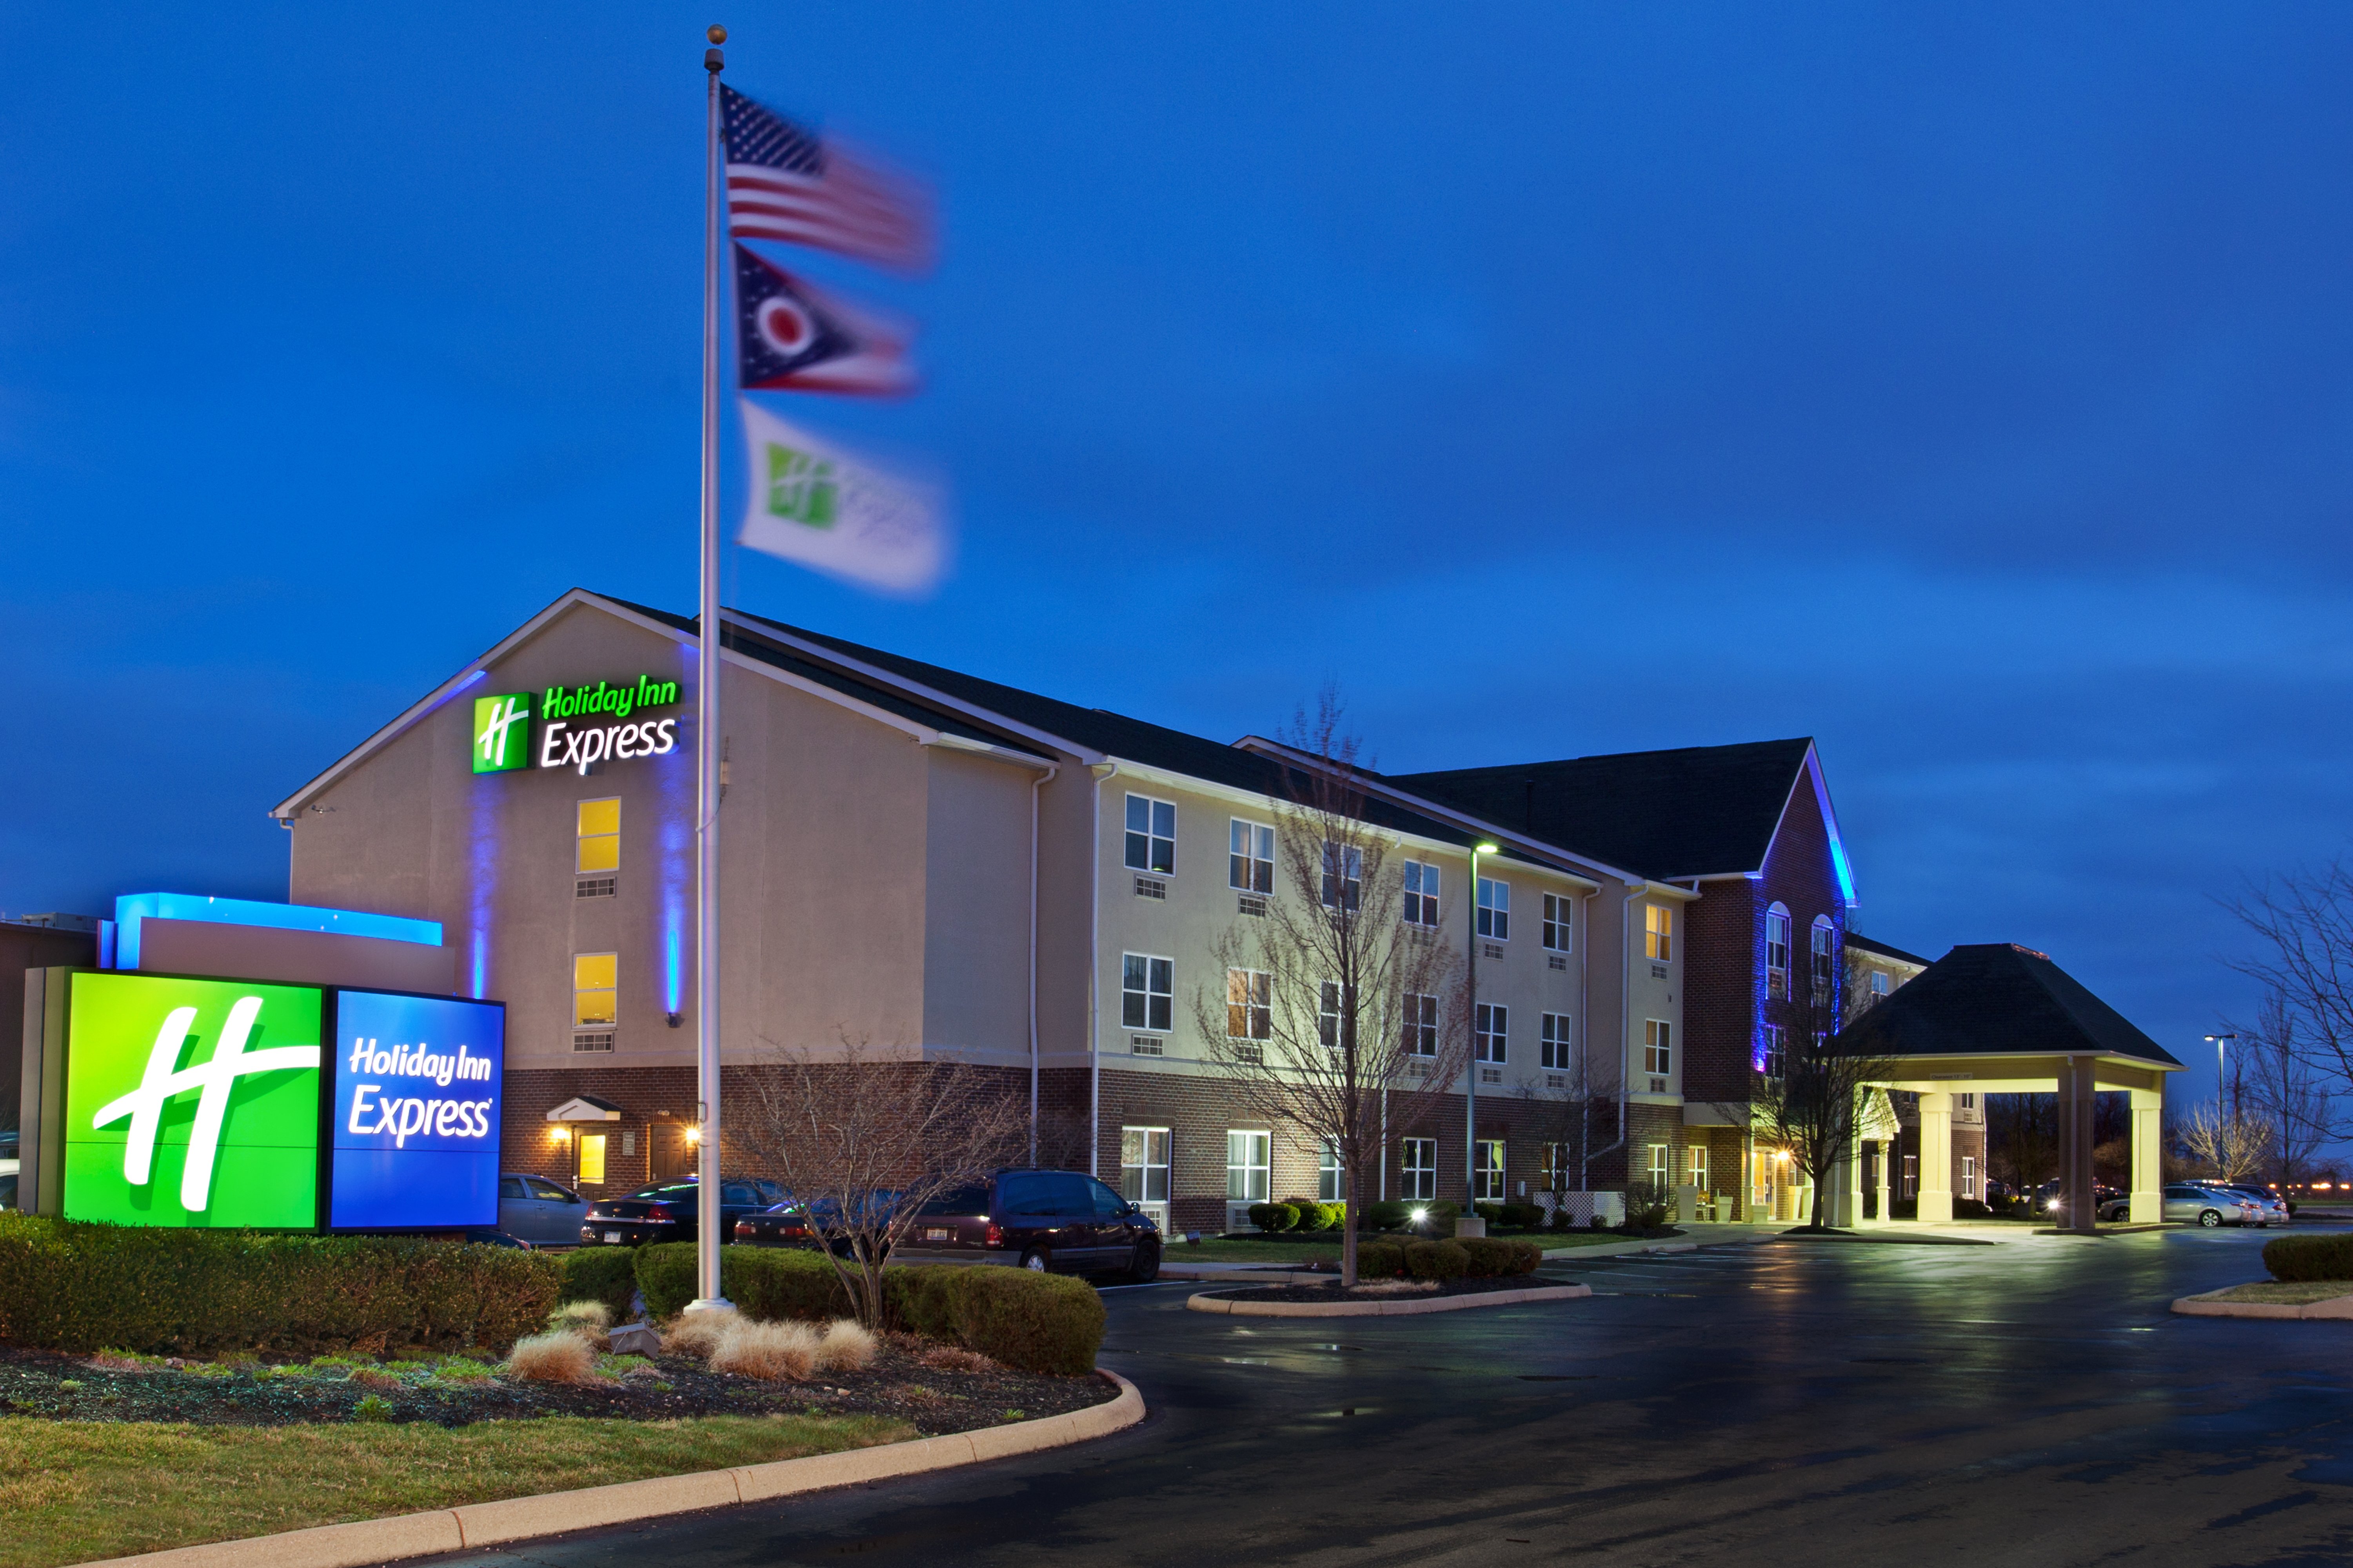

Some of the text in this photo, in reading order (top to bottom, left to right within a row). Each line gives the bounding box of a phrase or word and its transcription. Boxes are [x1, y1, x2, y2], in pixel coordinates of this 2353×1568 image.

[541, 675, 676, 719] Holiday Inn
[541, 719, 676, 775] Express
[349, 1037, 491, 1086] Holiday Inn
[348, 1084, 492, 1149] Express
